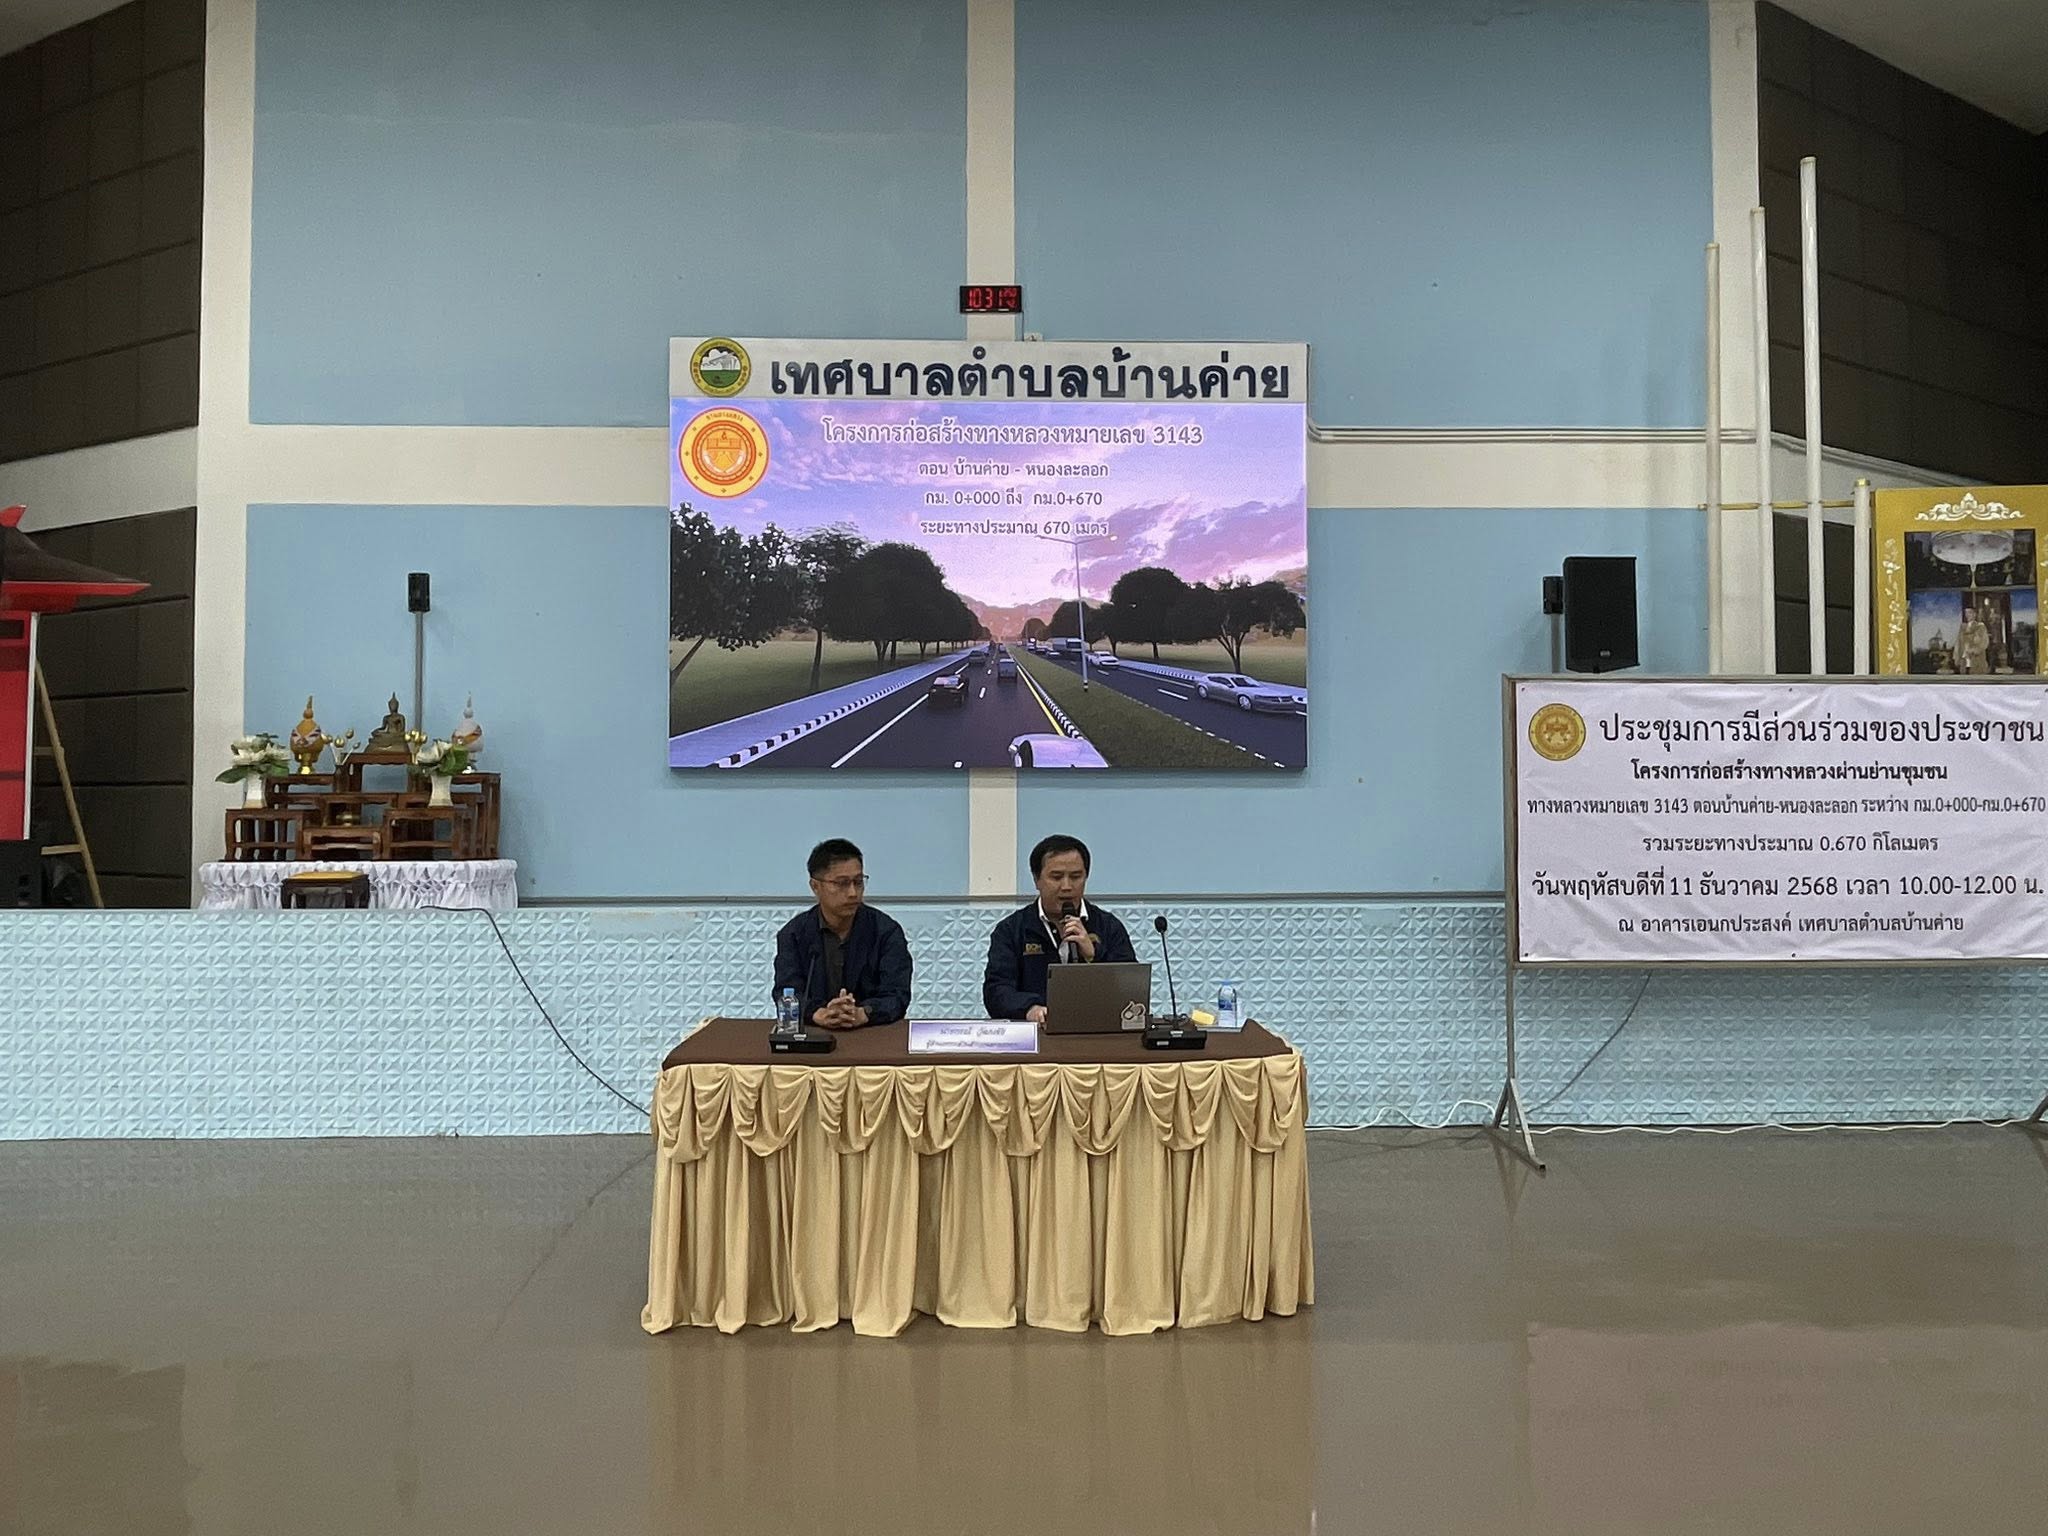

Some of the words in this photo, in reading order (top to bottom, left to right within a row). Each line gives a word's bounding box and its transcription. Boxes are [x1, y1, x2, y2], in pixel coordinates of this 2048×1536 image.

[771, 346, 1289, 399] เทศบาลตำบลบ้านค่าย
[823, 417, 1145, 443] โครงการก่อสร้างทางหลวงหมายเลข
[1153, 427, 1202, 444] 3143
[919, 463, 948, 476] ตอน
[954, 458, 1009, 476] บ้านค่าย
[1026, 464, 1108, 476] หนองละลอก
[926, 492, 949, 504] กม.
[954, 491, 1000, 504] 0+000
[1006, 488, 1022, 504] ถึง
[1033, 491, 1102, 505] กม.0+670
[920, 519, 1037, 534] ระยะทางประมาณ
[1043, 521, 1070, 535] 670
[1076, 522, 1108, 535] เมตร
[1599, 709, 2044, 752] ประชุมการมีส่วนร่วมของประชาชน
[1630, 758, 1948, 786] โครงการก่อสร้างทางหลวงผ่านย่านชุมชน
[1527, 798, 1649, 814] ทางหลวงหมายเลข
[1654, 798, 1688, 814] 3143
[1693, 794, 1858, 814] ตอนบ้านค่าย-หนองละลอก
[1861, 795, 1908, 812] ระหว่าง
[1914, 797, 2046, 812] กม.0+000-กม.0+670
[1643, 835, 1813, 851] รวมระยะทางประมาณ
[1819, 836, 1866, 851] 0.670
[1873, 831, 1938, 851] กิโลเมตร
[1532, 866, 1665, 900] วันพฤหัสบดีที่
[1670, 877, 1691, 895] 11
[1700, 871, 1778, 896] ธันวาคม
[1787, 876, 1838, 896] 2568
[1846, 878, 1890, 895] เวลา
[1900, 876, 2017, 895] 10.00-12.00
[2024, 877, 2044, 894] น.
[1618, 918, 1634, 932] ณ
[1641, 912, 1792, 932] อาคารเอนกประสงค์
[1799, 912, 1964, 932] เทศบาลตำบลบ้านค่าย
